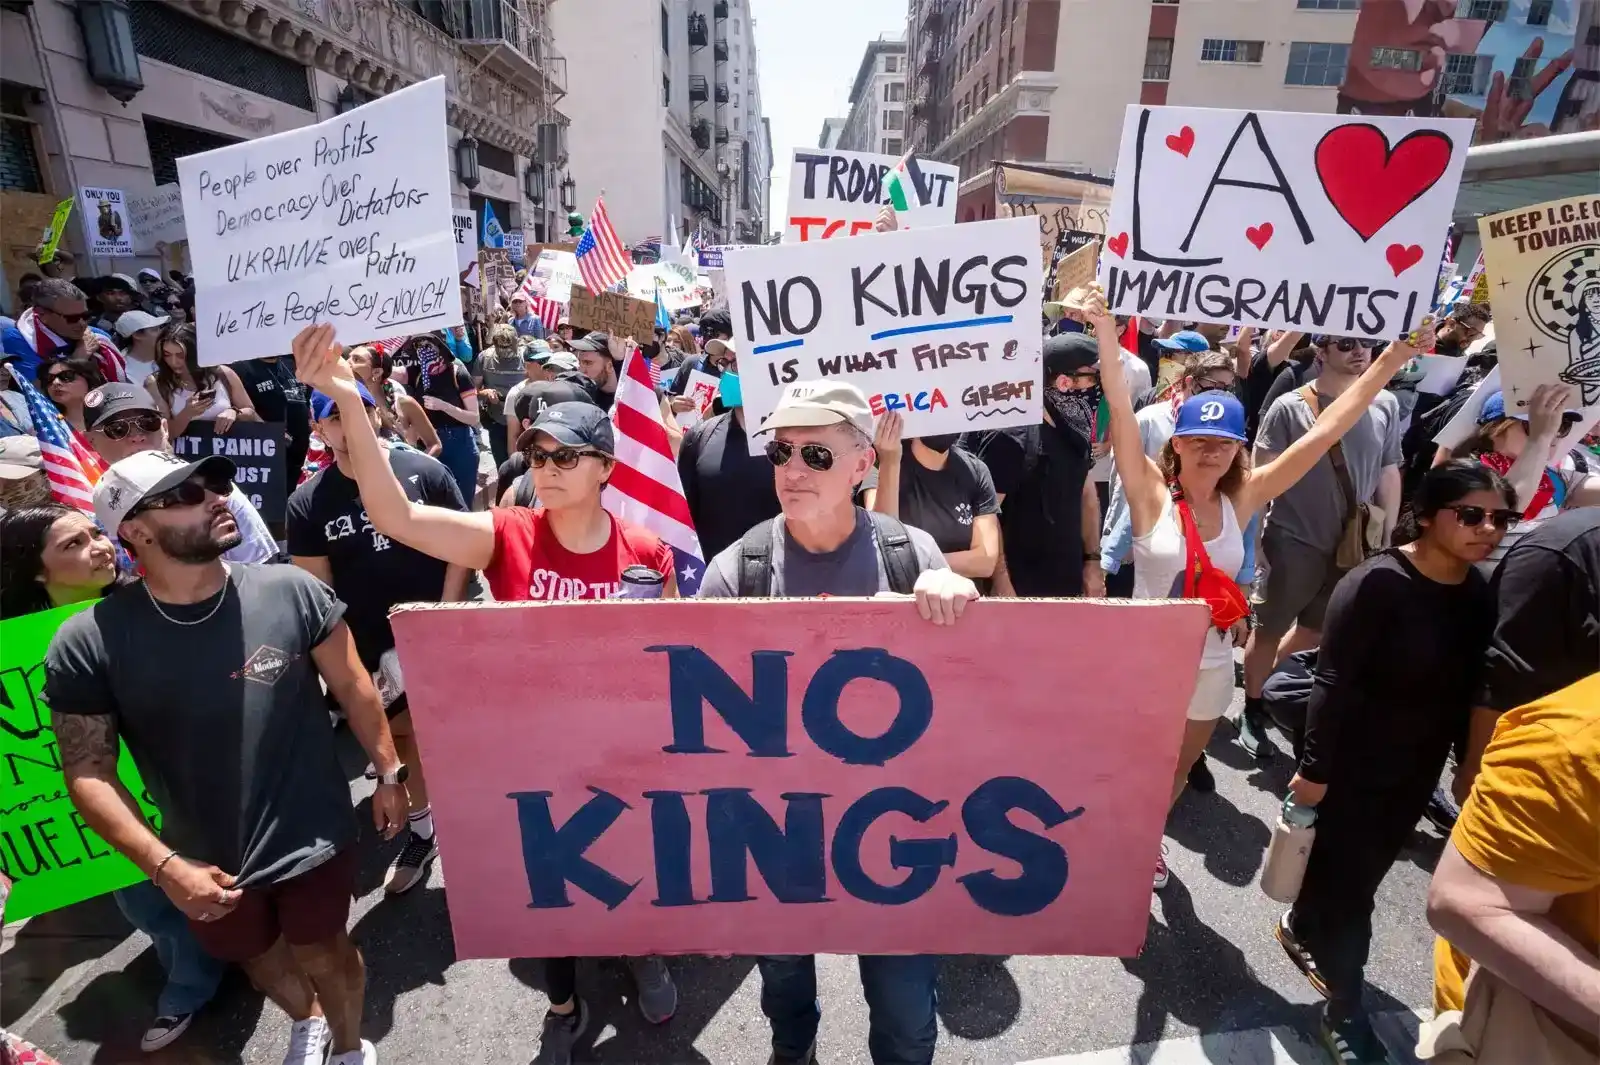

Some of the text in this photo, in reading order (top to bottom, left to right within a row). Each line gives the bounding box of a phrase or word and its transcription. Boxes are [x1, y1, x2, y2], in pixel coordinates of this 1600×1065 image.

[199, 121, 379, 200] People over Profits
[795, 153, 893, 207] TROOP
[85, 189, 121, 201] ONLY YOU
[216, 194, 319, 237] Democracy
[321, 173, 362, 208] Over
[337, 177, 430, 227] Dictators
[1133, 109, 1315, 267] LA
[1489, 211, 1542, 239] KEEP
[1547, 201, 1590, 226] I.C.E
[1513, 222, 1600, 254] TOVAAN
[227, 231, 380, 283] UKRAINE over
[364, 242, 417, 278] Putin
[214, 311, 239, 339] We
[242, 300, 276, 330] The
[283, 284, 344, 327] People
[344, 283, 379, 322] Say
[377, 276, 450, 325] ENOUGH
[635, 300, 649, 319] A
[740, 255, 1029, 342] NO KINGS
[1107, 266, 1418, 341] IMMIGRANTS!
[768, 358, 800, 387] IS
[817, 348, 899, 376] WHAT
[911, 341, 990, 372] FIRST
[961, 380, 1035, 407] GREAT
[1200, 401, 1225, 422] D
[212, 437, 277, 457] PANIC
[371, 531, 392, 552] LA
[529, 568, 587, 600] STOP
[253, 658, 283, 674] Modelo
[642, 643, 935, 768] NO
[505, 775, 1086, 917] KINGS
